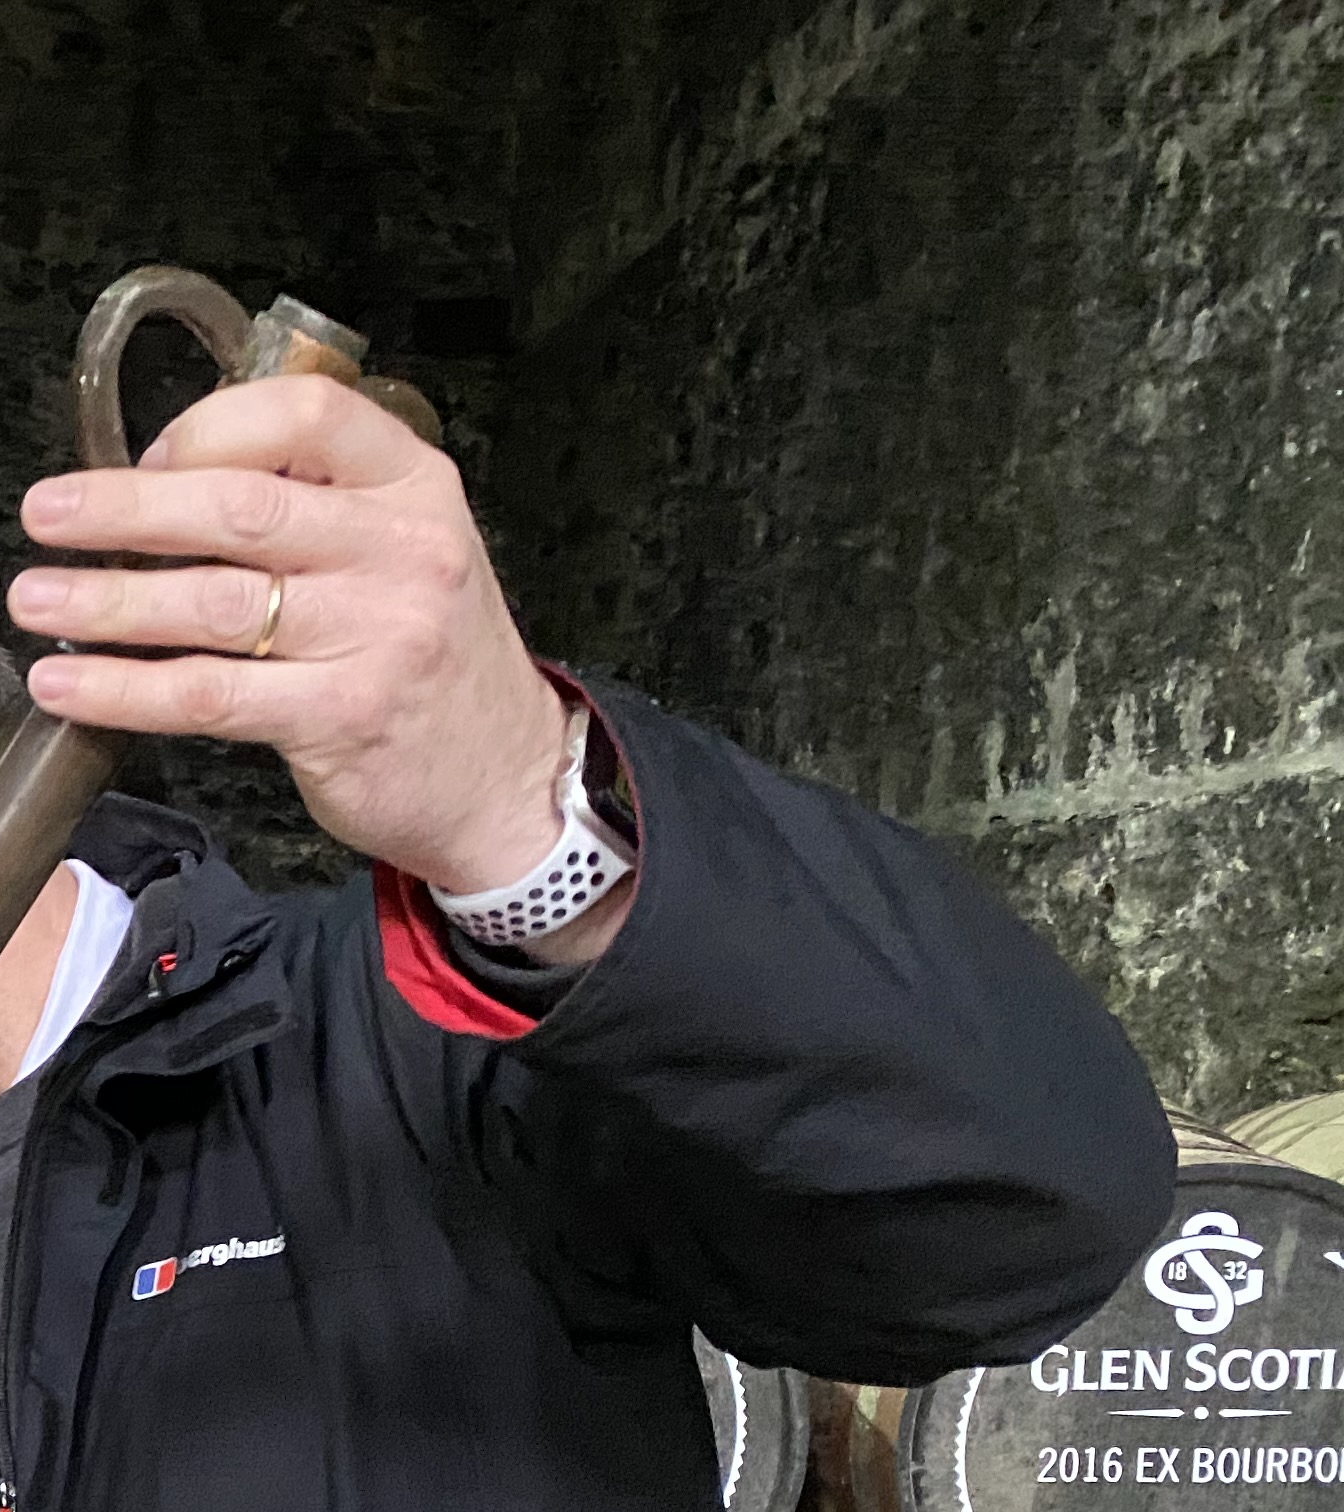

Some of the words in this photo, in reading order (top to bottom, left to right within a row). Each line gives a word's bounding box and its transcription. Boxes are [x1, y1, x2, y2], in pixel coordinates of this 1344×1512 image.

[1167, 1262, 1187, 1281] 18
[1224, 1260, 1247, 1281] 32
[1030, 1344, 1171, 1396] GLEN
[1184, 1343, 1344, 1392] SCOTI
[1037, 1447, 1123, 1483] 2016
[1136, 1448, 1180, 1483] EX
[1192, 1448, 1344, 1484] BOURBO
